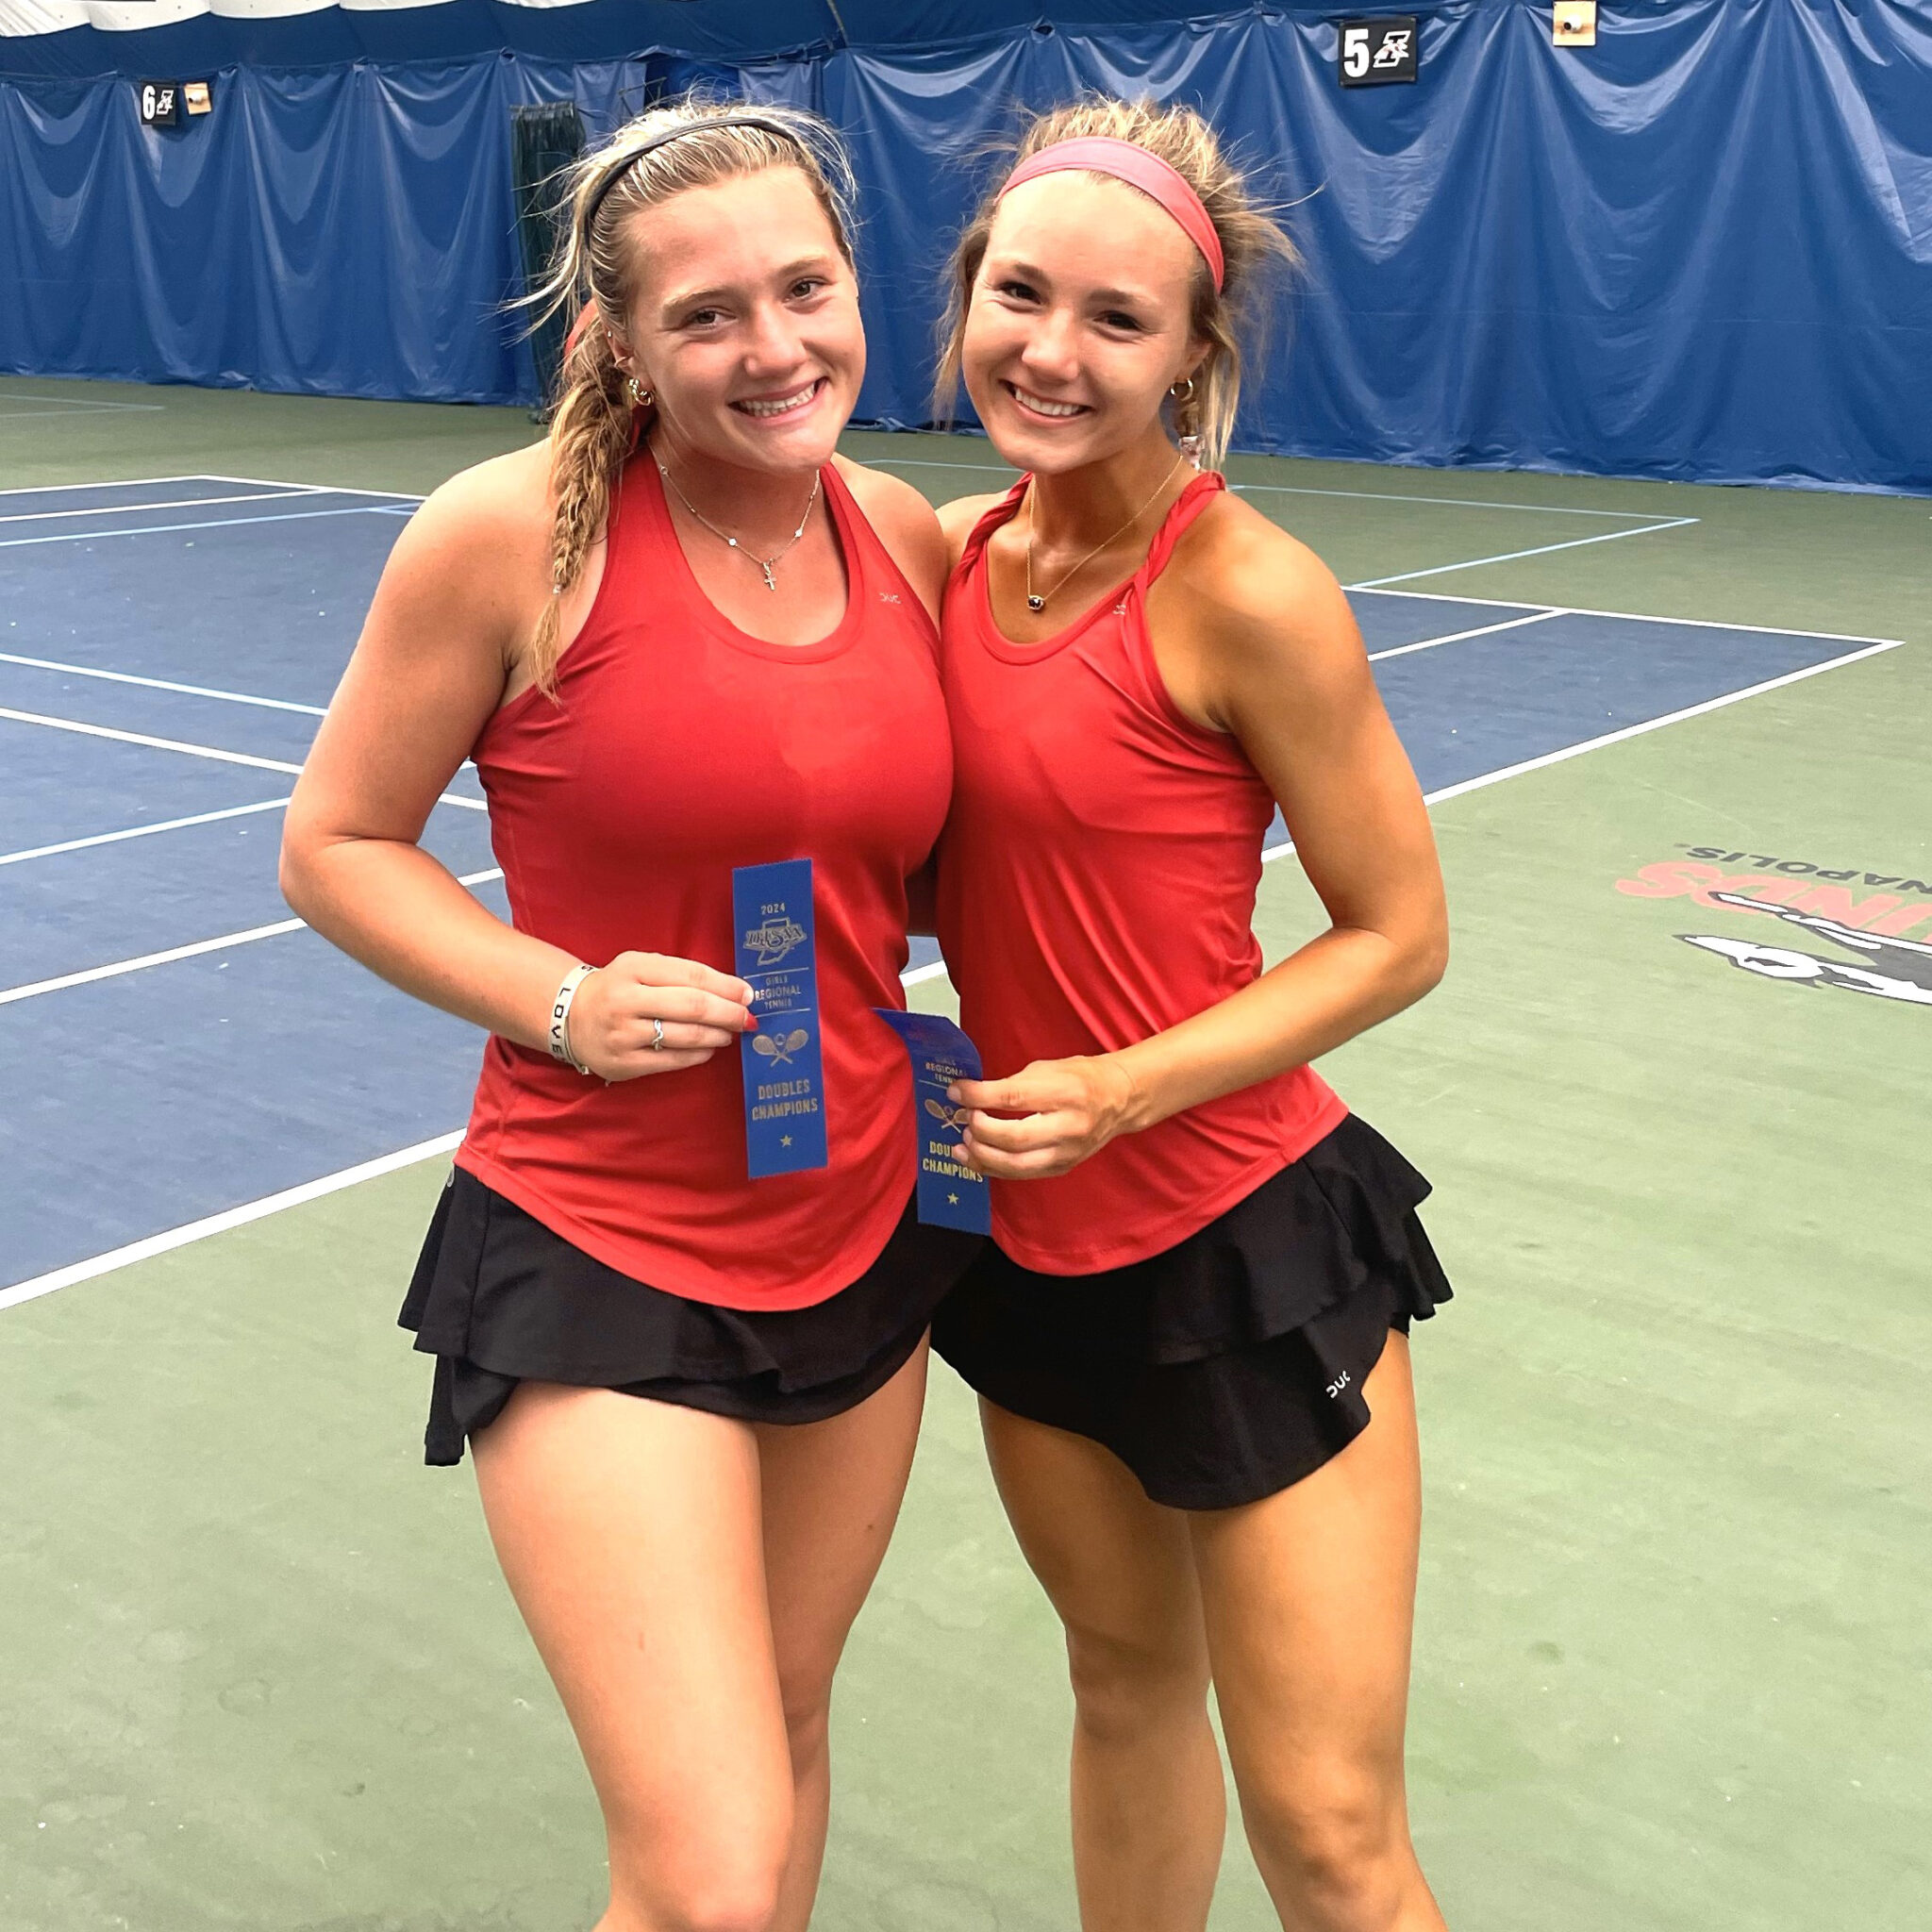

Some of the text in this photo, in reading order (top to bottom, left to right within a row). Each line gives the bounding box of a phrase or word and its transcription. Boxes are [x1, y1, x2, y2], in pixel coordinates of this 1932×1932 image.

[1343, 28, 1370, 77] 5
[142, 85, 156, 120] 6
[760, 902, 786, 916] 2024
[755, 985, 802, 1002] REGIONAL
[551, 987, 572, 1055] LOVE
[758, 1078, 811, 1101] DOUBLES
[752, 1097, 819, 1122] CHAMPIONS
[922, 1158, 984, 1183] CHAMPIONS
